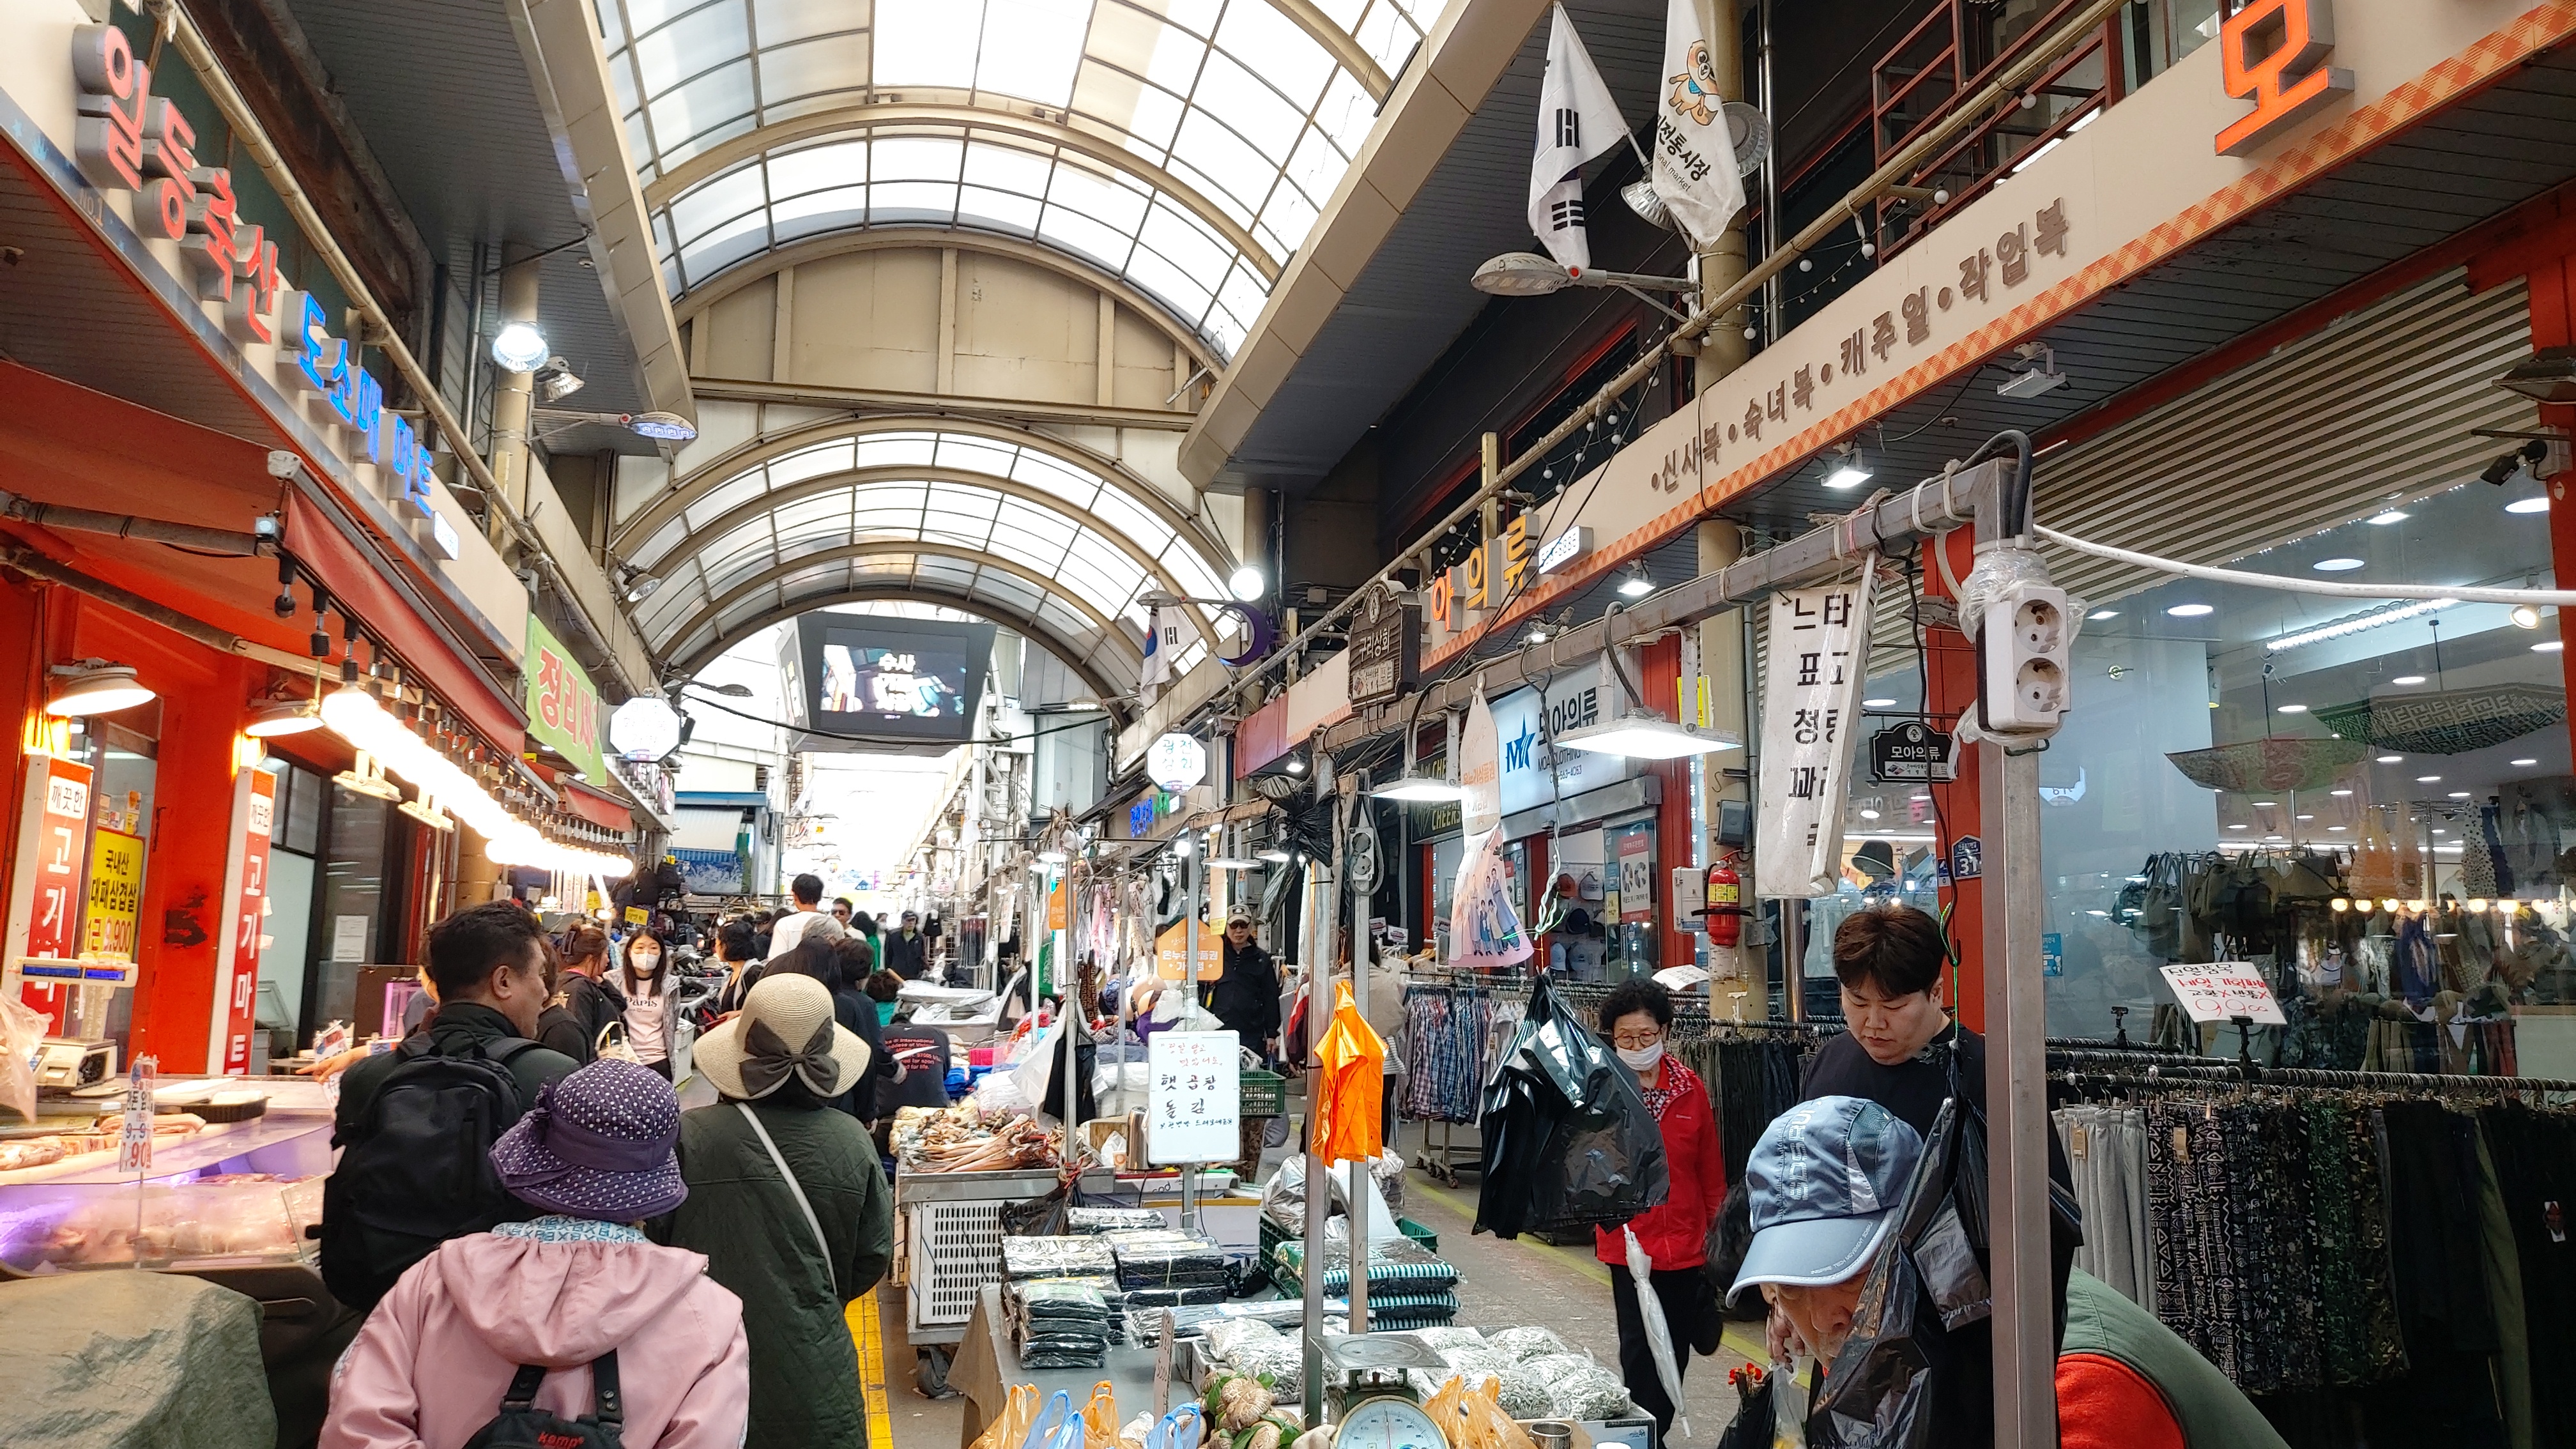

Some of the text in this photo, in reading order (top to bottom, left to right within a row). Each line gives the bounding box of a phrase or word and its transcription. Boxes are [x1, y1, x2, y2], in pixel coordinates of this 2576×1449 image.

[1668, 166, 1692, 192] market
[101, 26, 434, 518] 일등축산 도소매 마트
[1662, 197, 2069, 495] 신사복 숙녀복 캐주얼 작업복
[1360, 625, 1390, 663] 구리상회
[1796, 650, 1850, 687] 표고
[1890, 745, 1941, 760] 모아의류
[51, 785, 84, 814] 깨끗한
[105, 848, 130, 876] 국내산
[1959, 857, 1978, 875] 31
[90, 877, 137, 913] 대패삼겹살
